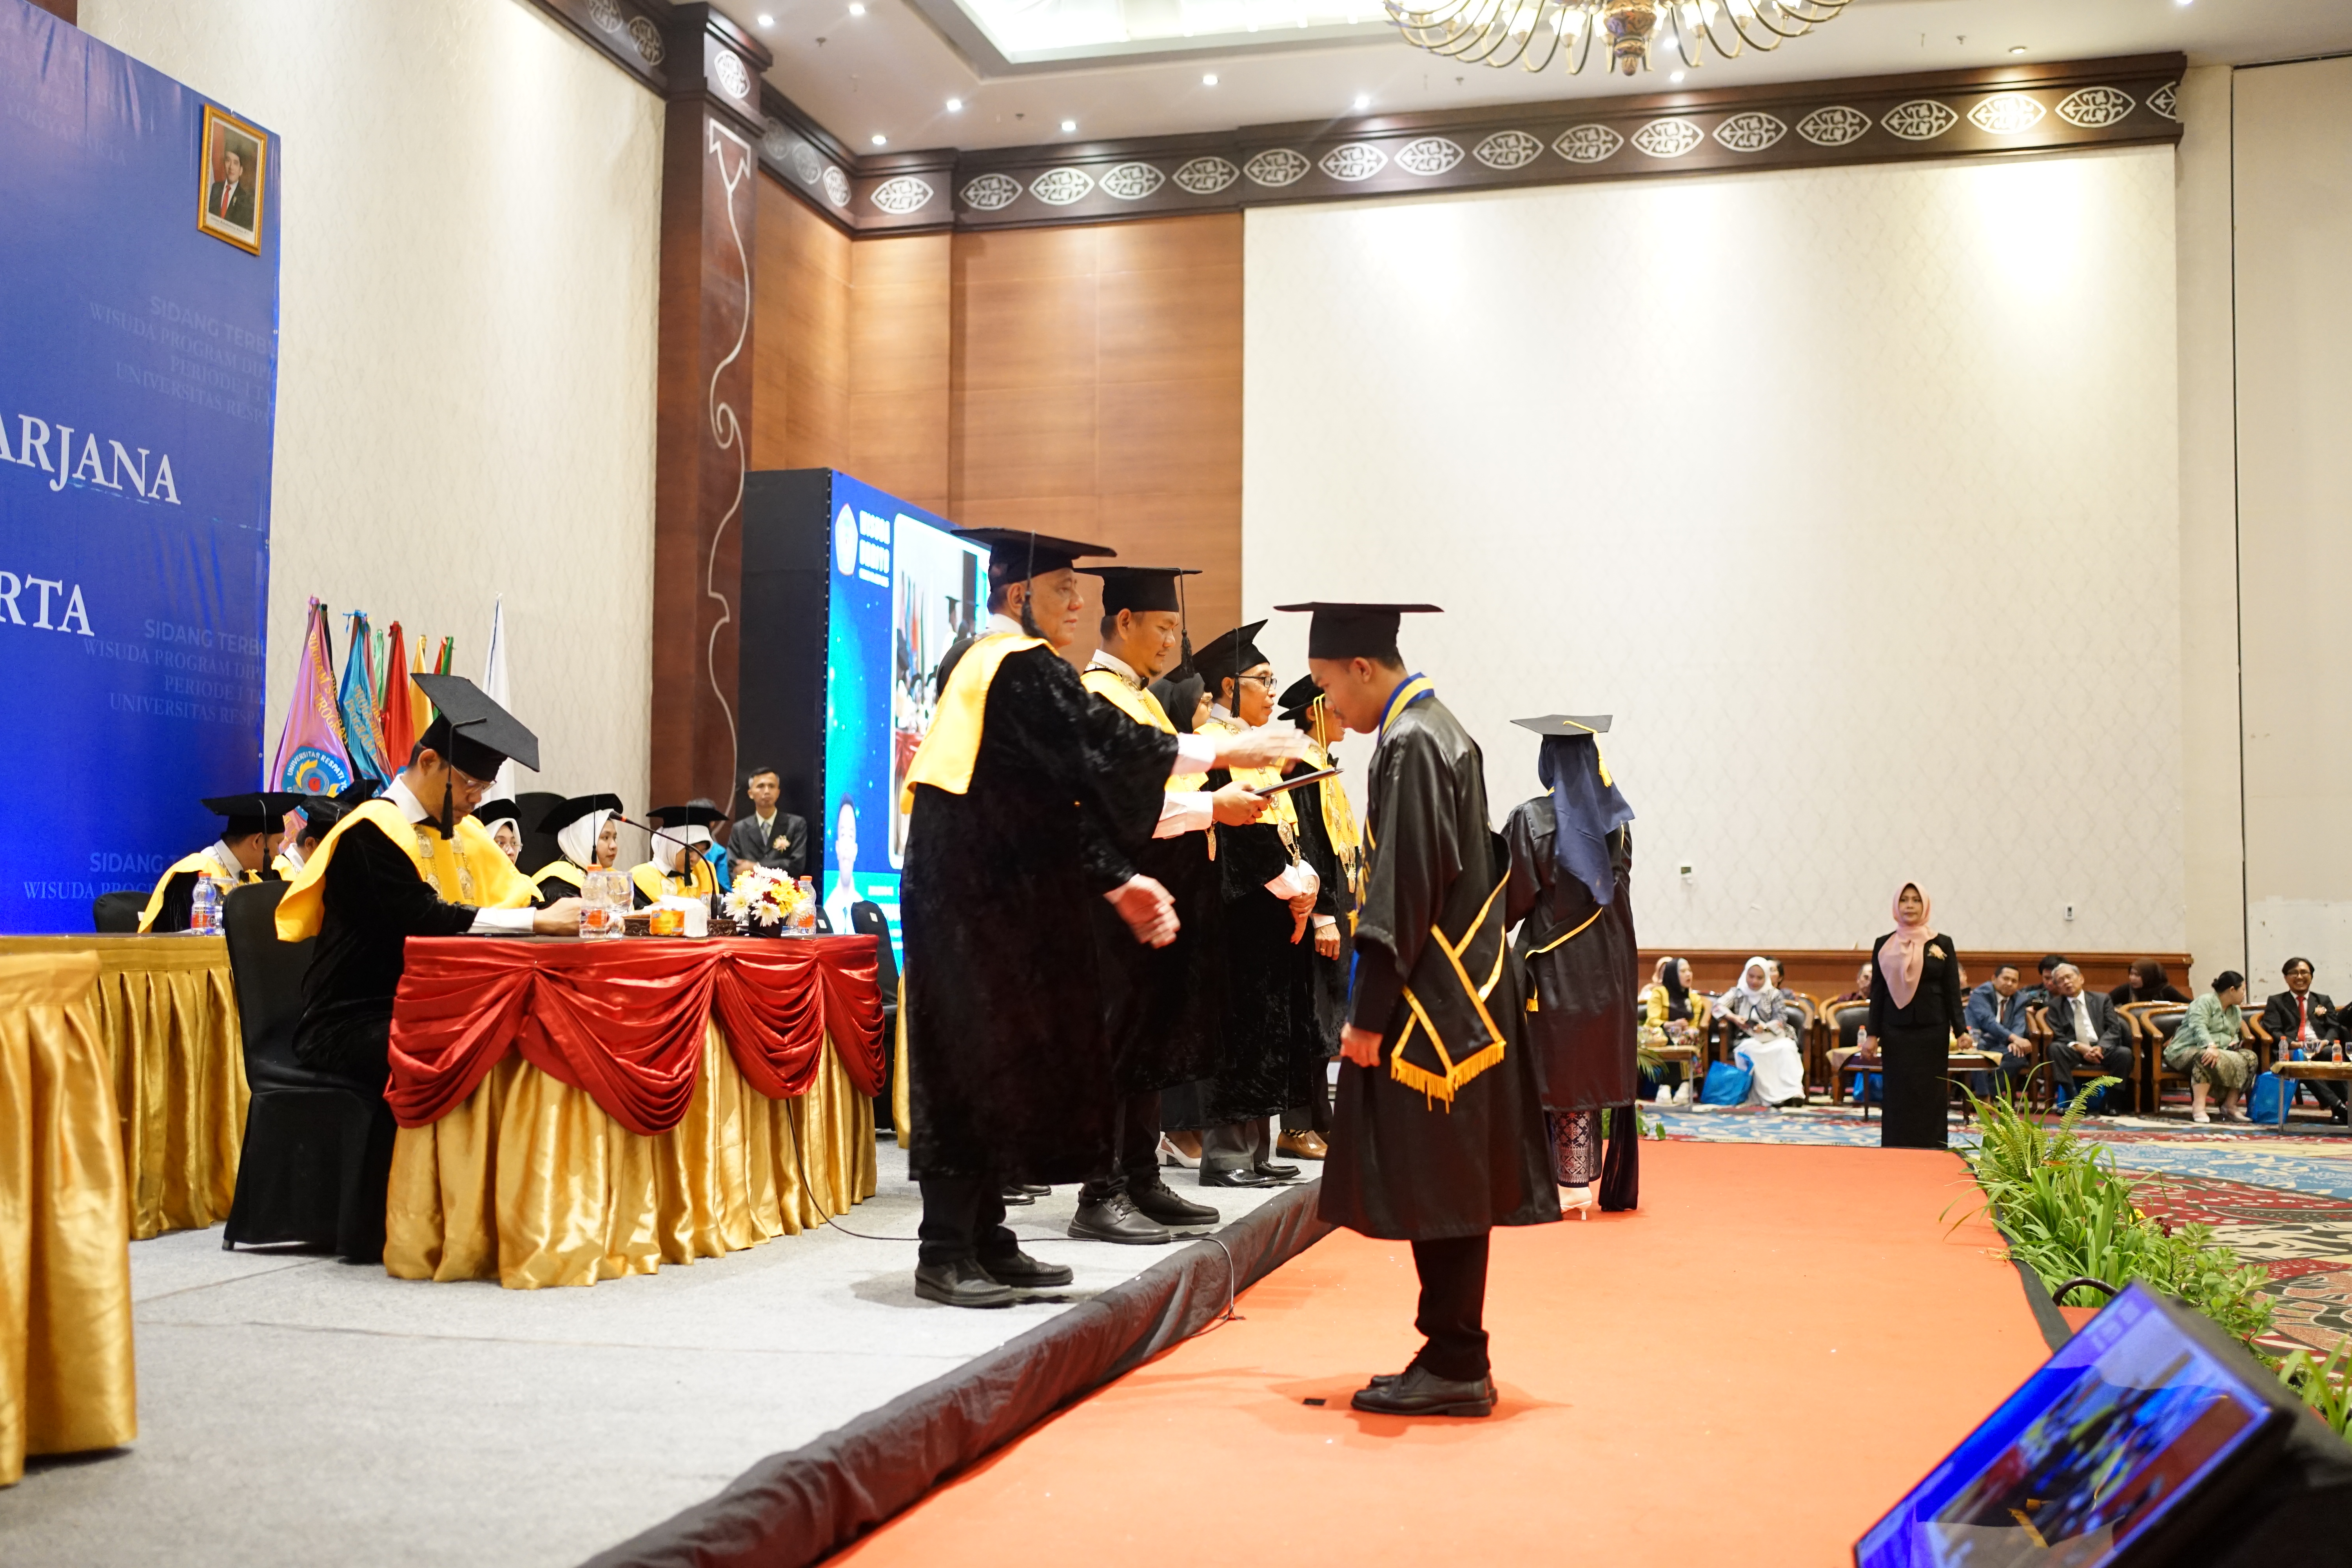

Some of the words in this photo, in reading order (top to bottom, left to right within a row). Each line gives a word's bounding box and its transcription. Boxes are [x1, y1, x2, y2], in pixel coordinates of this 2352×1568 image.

[150, 295, 220, 338] SIDANG
[89, 301, 156, 341] WISUDA
[161, 327, 237, 369] PROGRAM
[115, 360, 221, 410] UNIVERSITAS
[171, 355, 240, 393] PERIODE
[144, 618, 213, 648] SIDANG
[83, 637, 150, 664] WISUDA
[155, 649, 230, 677] PROGRAM
[163, 674, 235, 701] PERIODE
[109, 691, 216, 722] UNIVERSITAS
[287, 750, 320, 776] UNIVERSITAS
[320, 754, 345, 780] RESPATI
[89, 852, 163, 874] SIDANG
[23, 880, 96, 899] WISUDA
